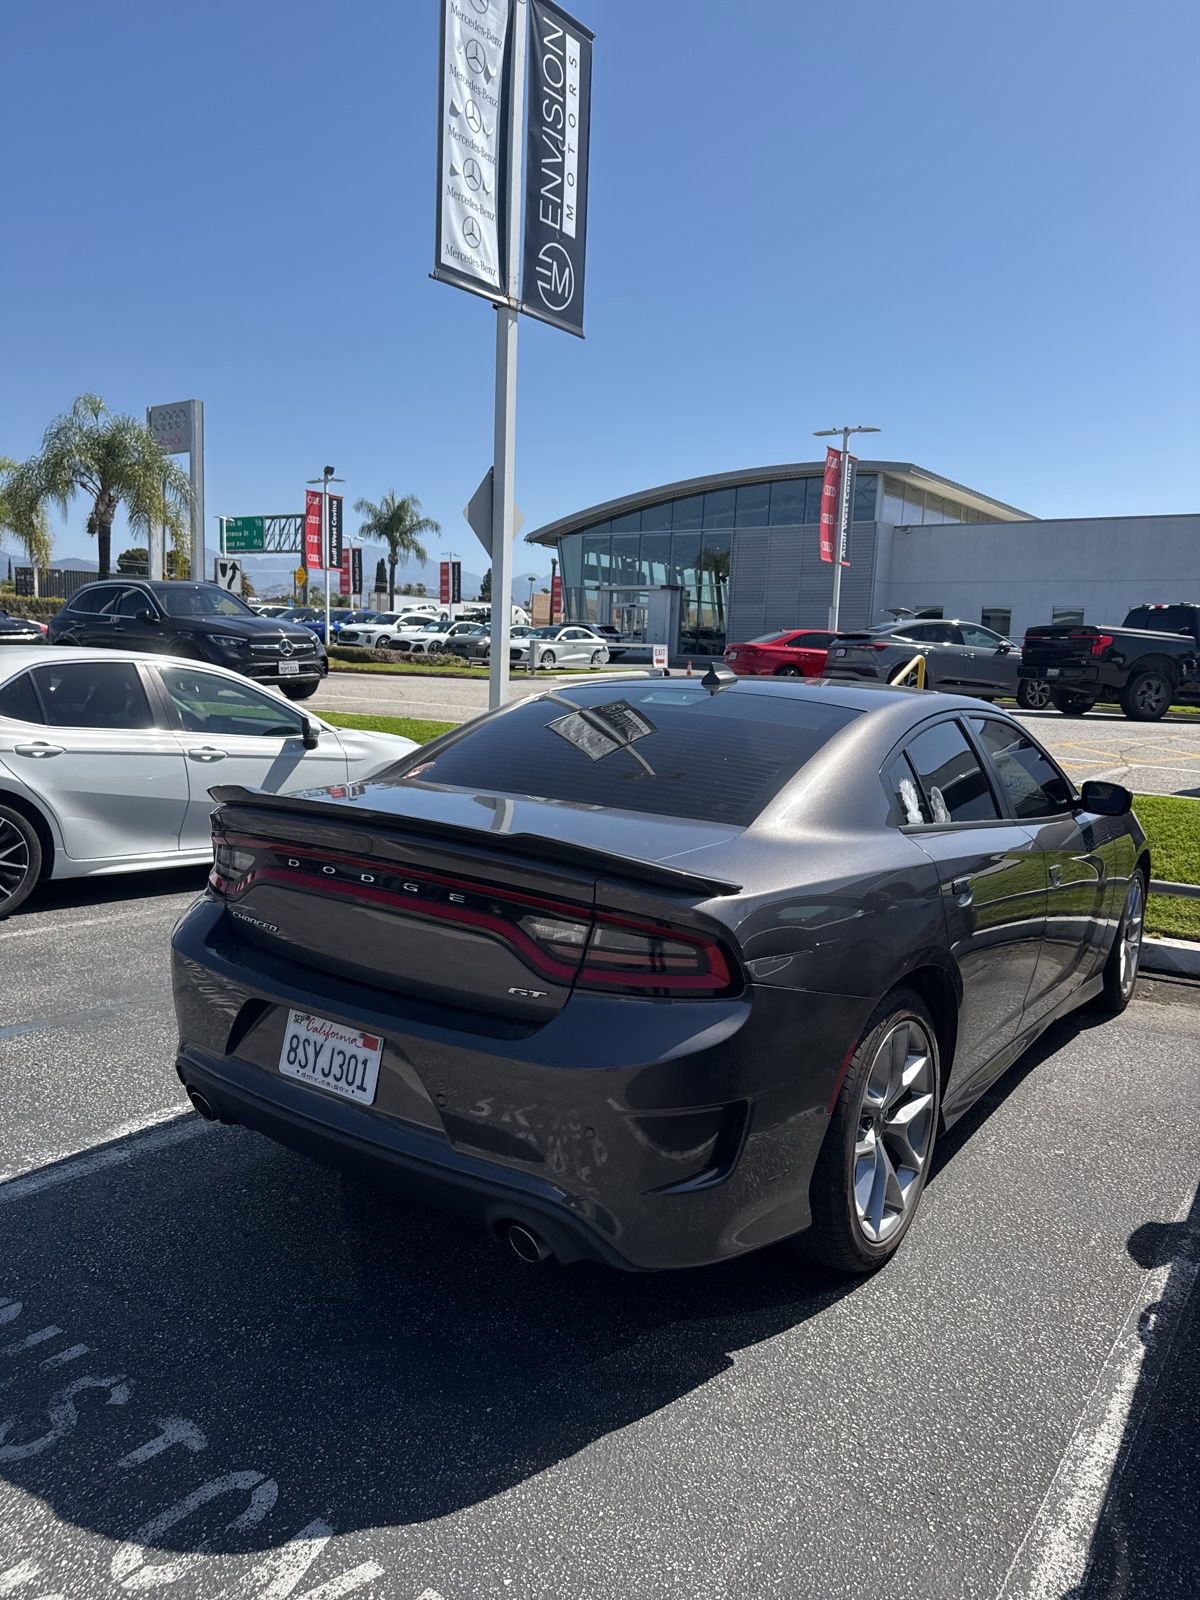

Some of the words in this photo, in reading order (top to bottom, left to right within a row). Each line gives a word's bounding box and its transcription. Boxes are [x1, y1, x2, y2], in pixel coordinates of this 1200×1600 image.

[450, 1, 503, 49] Mercedes-Benz
[449, 63, 498, 108] Mercedes-Benz
[539, 16, 564, 230] ENVISION
[566, 56, 579, 221] MOTORS
[446, 184, 495, 221] Mercedes-Benz
[445, 244, 497, 277] Mercedes-Benz
[287, 858, 466, 904] DODGE
[232, 911, 278, 932] CHARGER
[508, 986, 548, 999] GT
[293, 1013, 305, 1024] SEP
[306, 1017, 364, 1048] California
[286, 1034, 369, 1093] 8SYJ301
[301, 1072, 349, 1093] dmv.ca.gov
